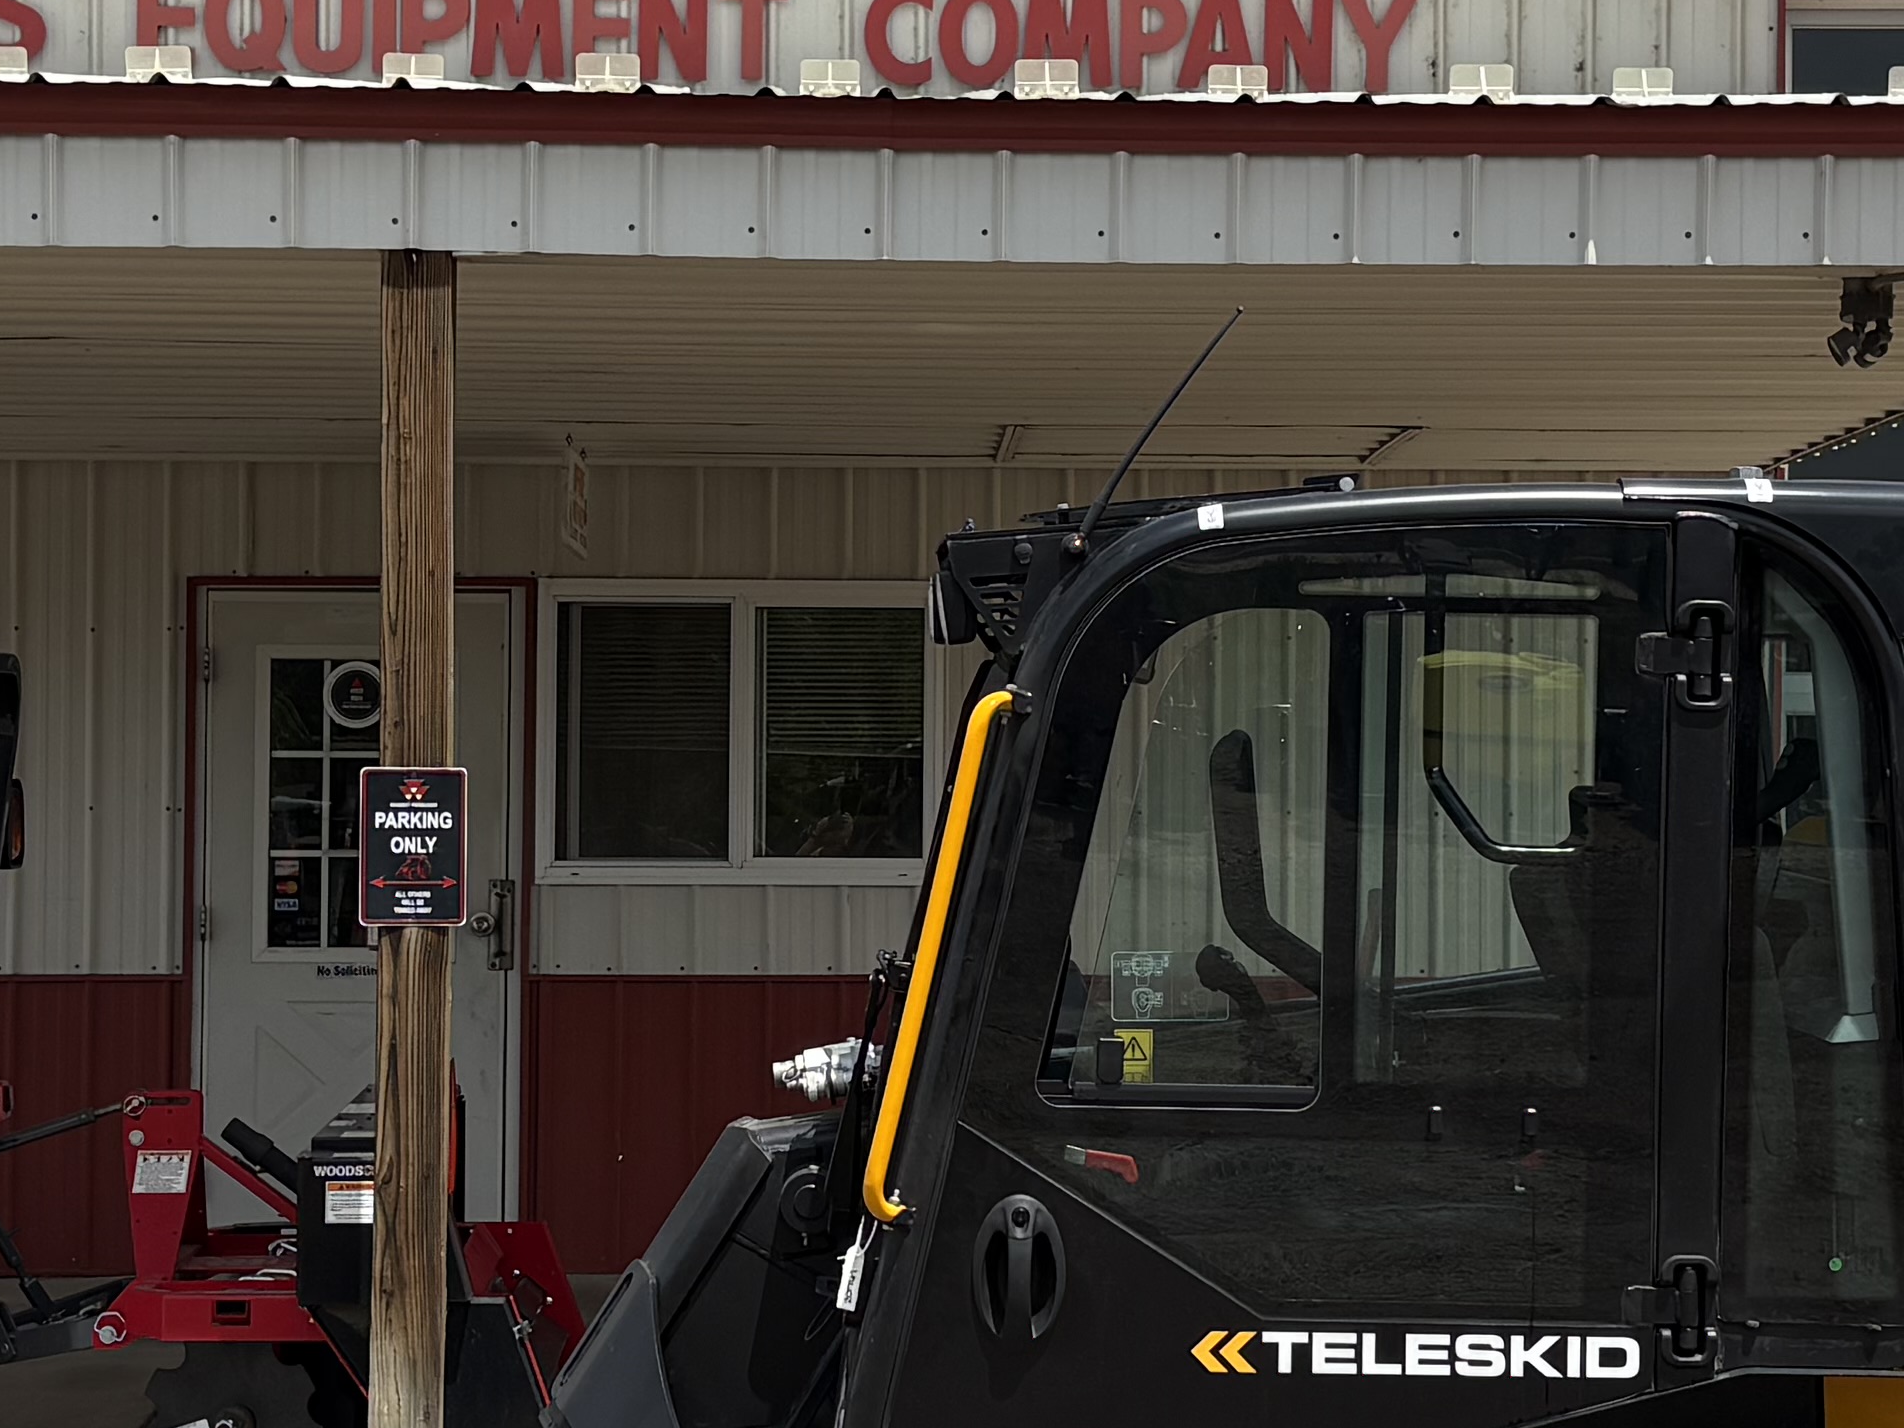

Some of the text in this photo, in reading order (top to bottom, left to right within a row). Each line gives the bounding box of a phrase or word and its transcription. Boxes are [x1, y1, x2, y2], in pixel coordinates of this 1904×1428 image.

[374, 811, 453, 829] PARKING
[390, 836, 437, 854] ONLY
[317, 965, 378, 976] No Solicitin
[1261, 1330, 1641, 1379] TELESKID
